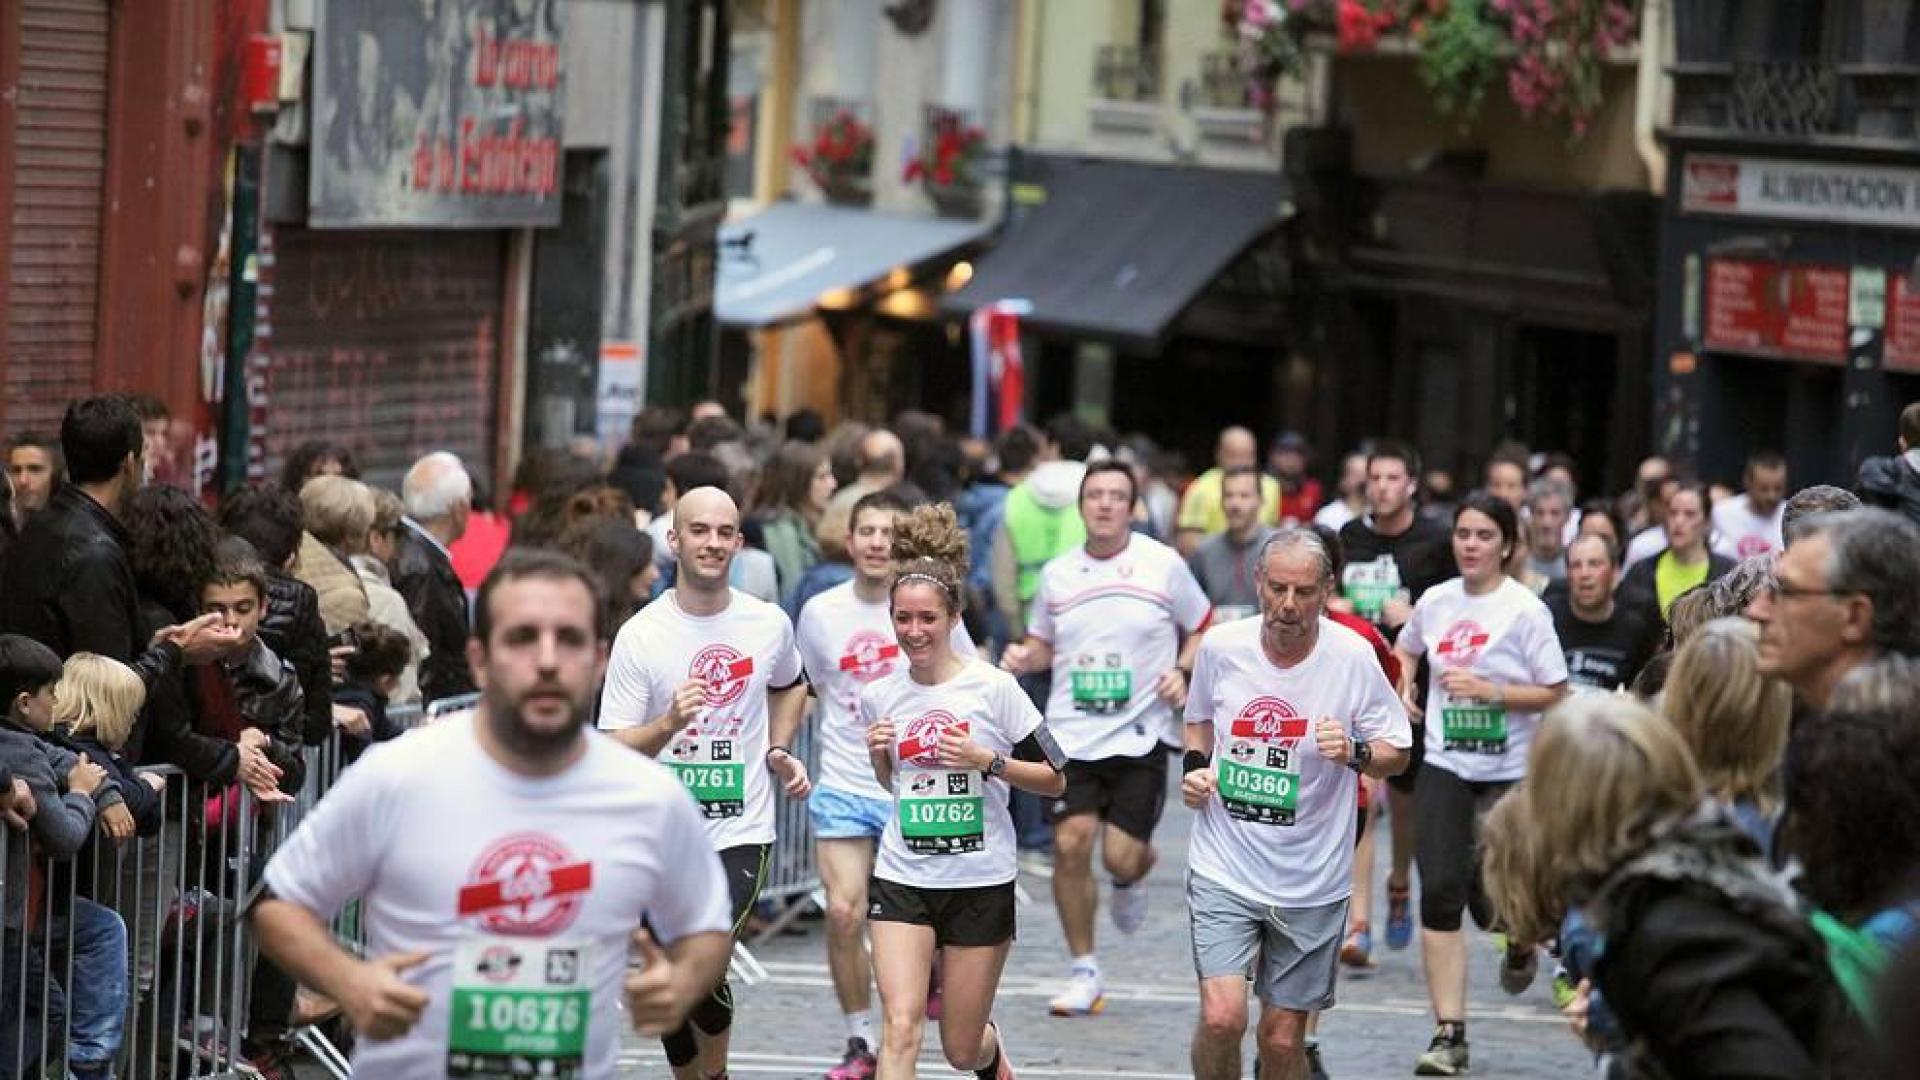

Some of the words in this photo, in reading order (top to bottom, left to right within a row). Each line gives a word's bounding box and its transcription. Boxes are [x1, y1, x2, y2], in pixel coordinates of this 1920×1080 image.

[681, 767, 736, 788] 0761
[1226, 765, 1291, 797] 10360
[908, 803, 976, 824] 10762
[467, 993, 580, 1033] 10676
